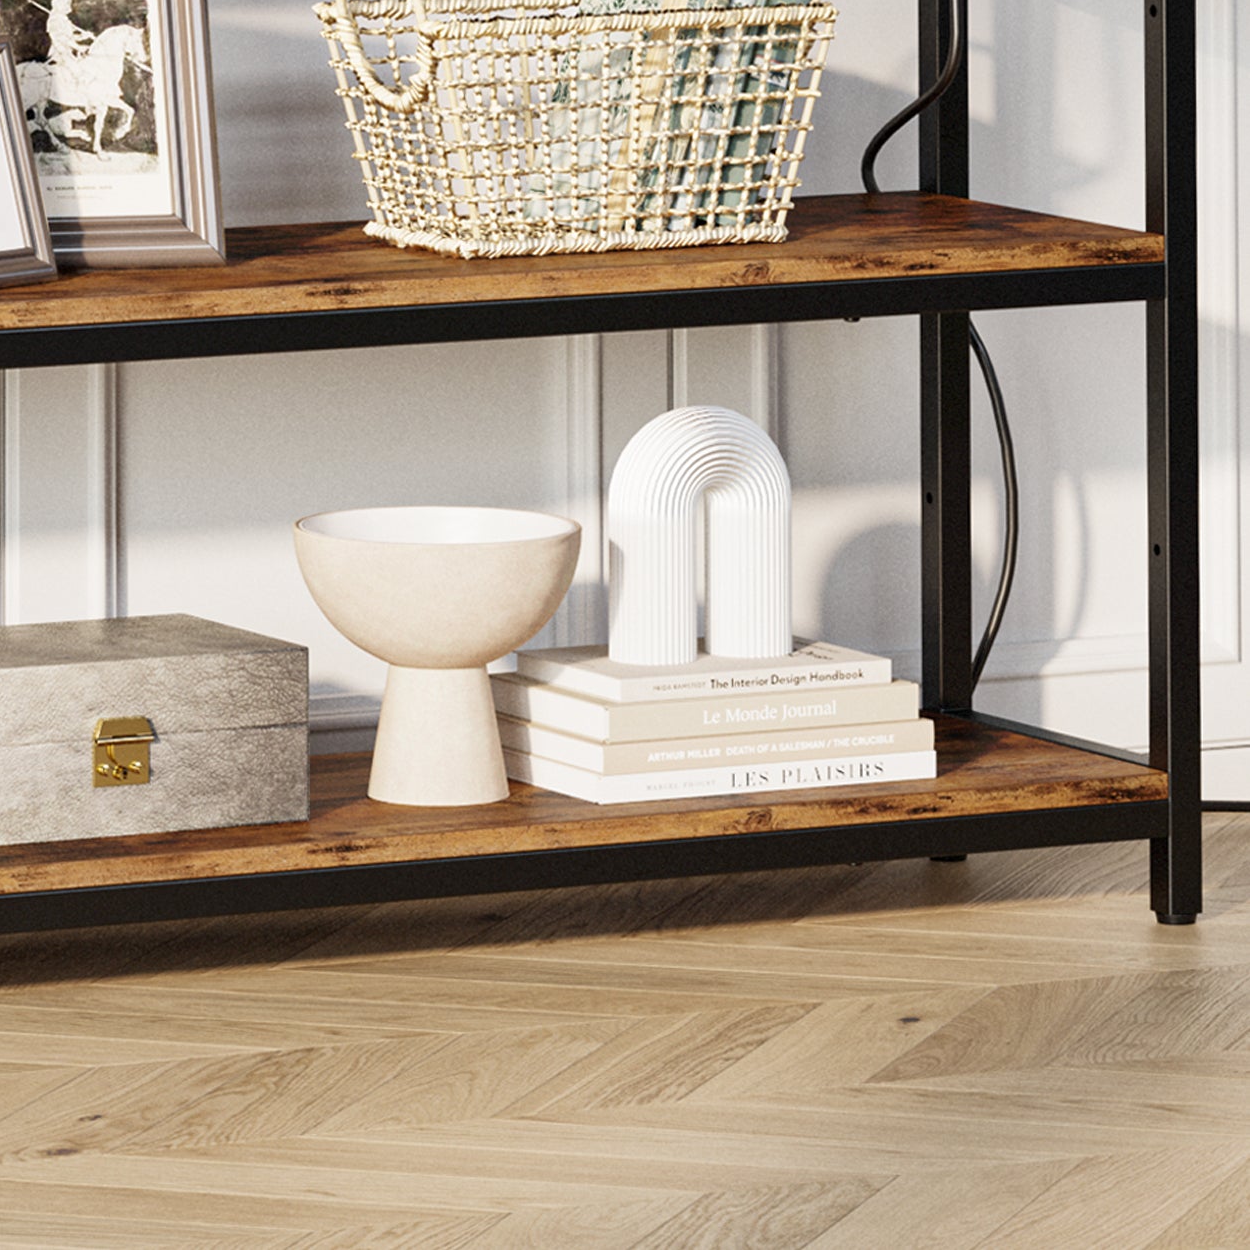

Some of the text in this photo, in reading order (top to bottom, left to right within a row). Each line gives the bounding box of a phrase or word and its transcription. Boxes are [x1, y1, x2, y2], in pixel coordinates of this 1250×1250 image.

[710, 668, 865, 689] The Interior Design Handbook
[702, 699, 837, 725] Le Monde Journal
[647, 750, 686, 763] ARTHUR
[687, 747, 722, 760] MILLER
[726, 744, 755, 757] DEATH
[757, 742, 769, 754] OF
[770, 742, 778, 753] A
[778, 738, 826, 752] SALESMAN
[832, 736, 851, 748] THE
[851, 733, 895, 747] CRUCIBLE
[731, 771, 769, 788] LES
[782, 761, 885, 784] PLAISIRS
